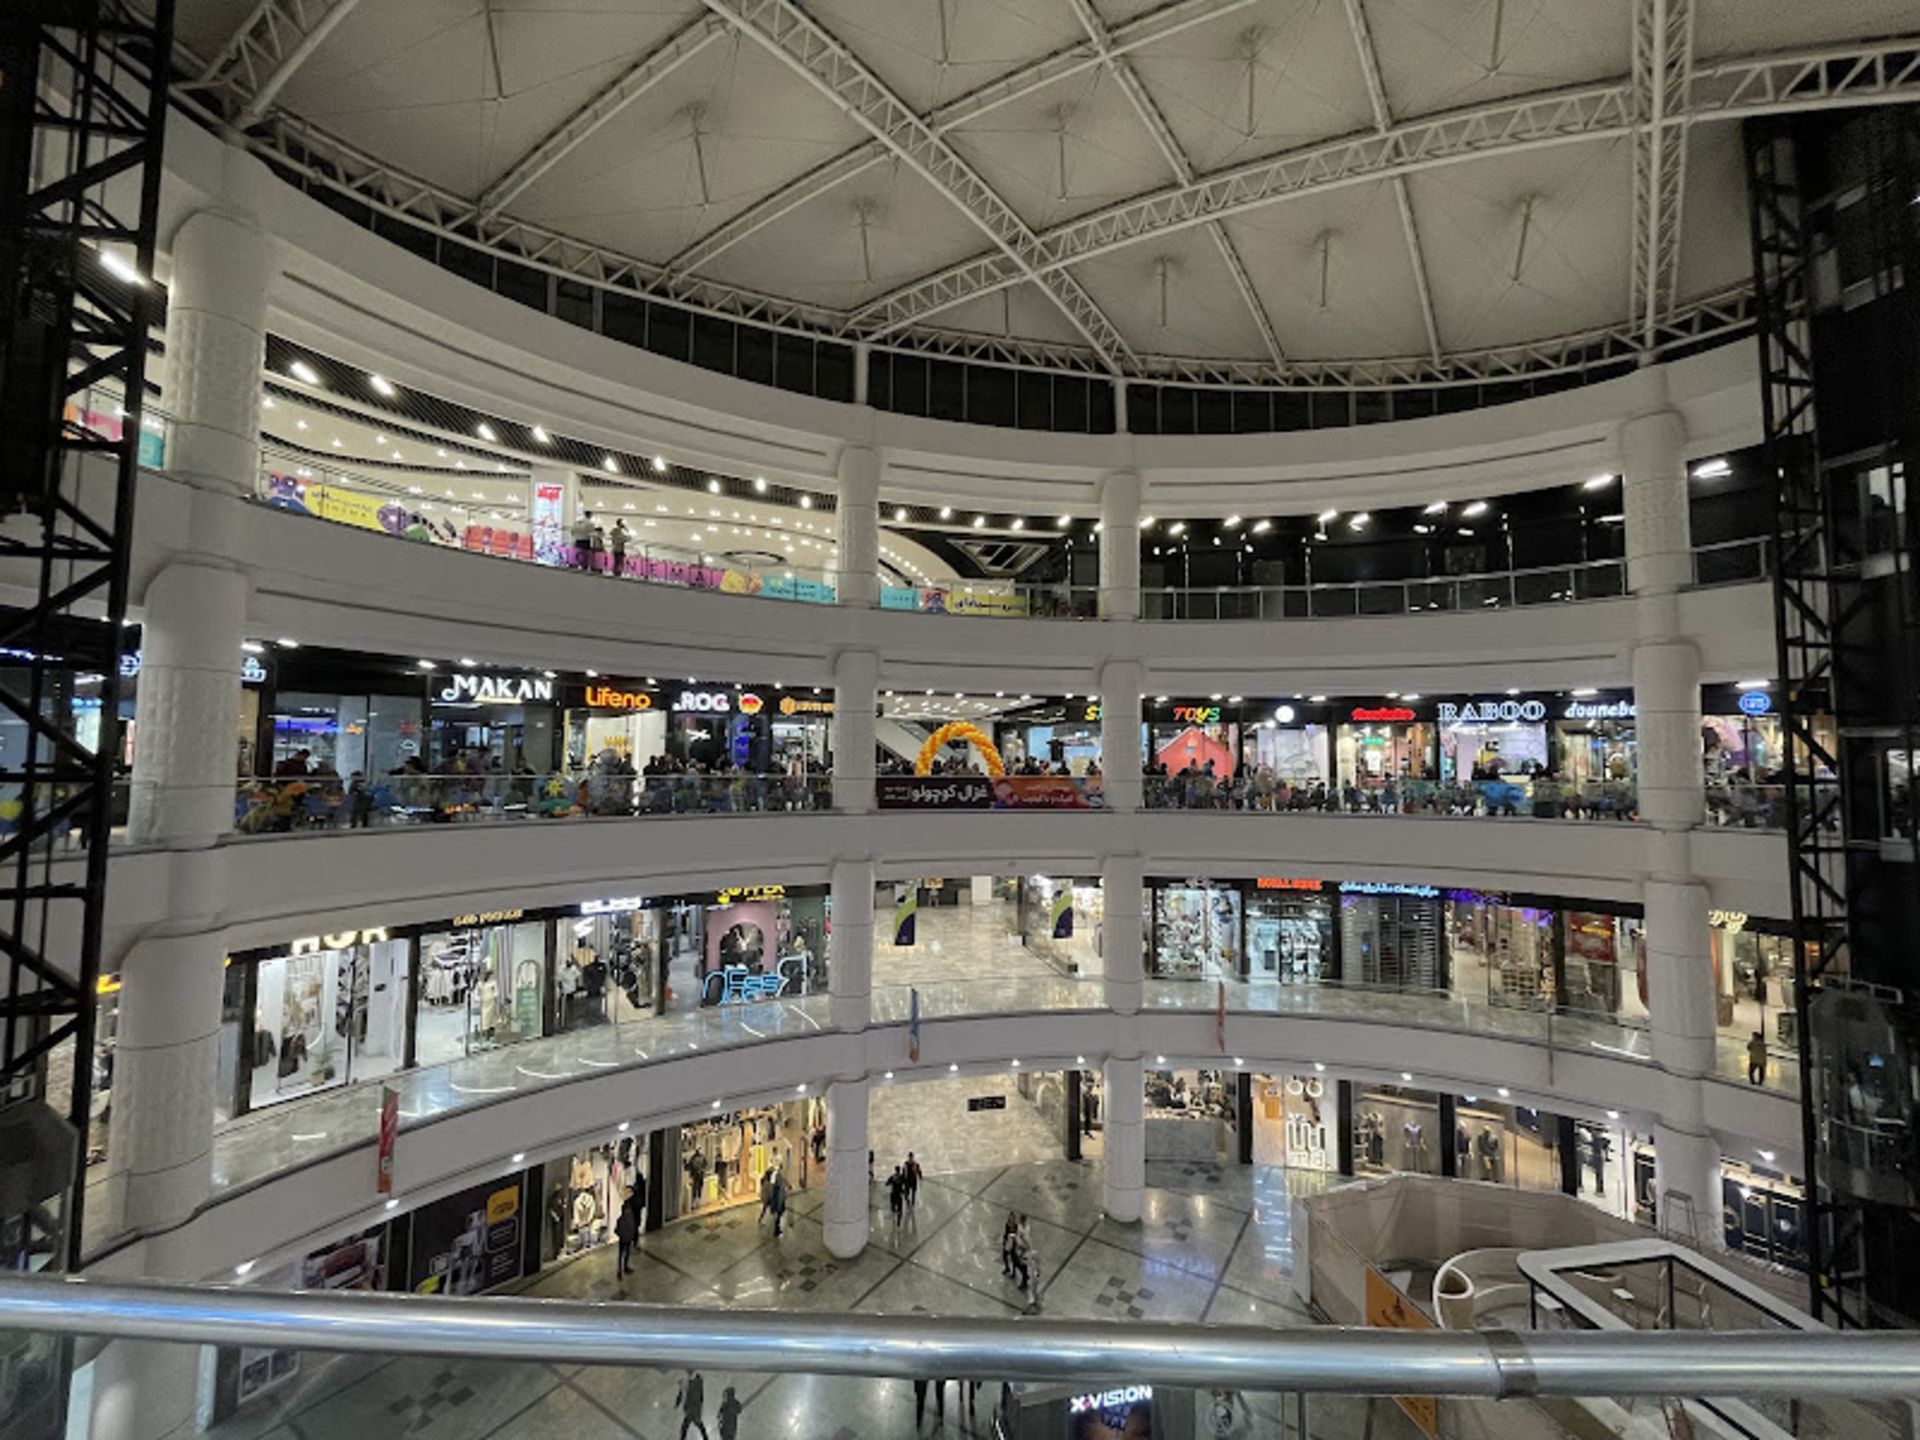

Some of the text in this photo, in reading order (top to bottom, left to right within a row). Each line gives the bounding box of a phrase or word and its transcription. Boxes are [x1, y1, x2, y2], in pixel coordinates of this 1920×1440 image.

[441, 674, 553, 701] MAKAN
[585, 686, 651, 709] Lifeno
[1173, 707, 1221, 723] TOYS
[1437, 701, 1546, 721] RABOO
[911, 783, 957, 804] کوچولو
[957, 784, 989, 803] غزال
